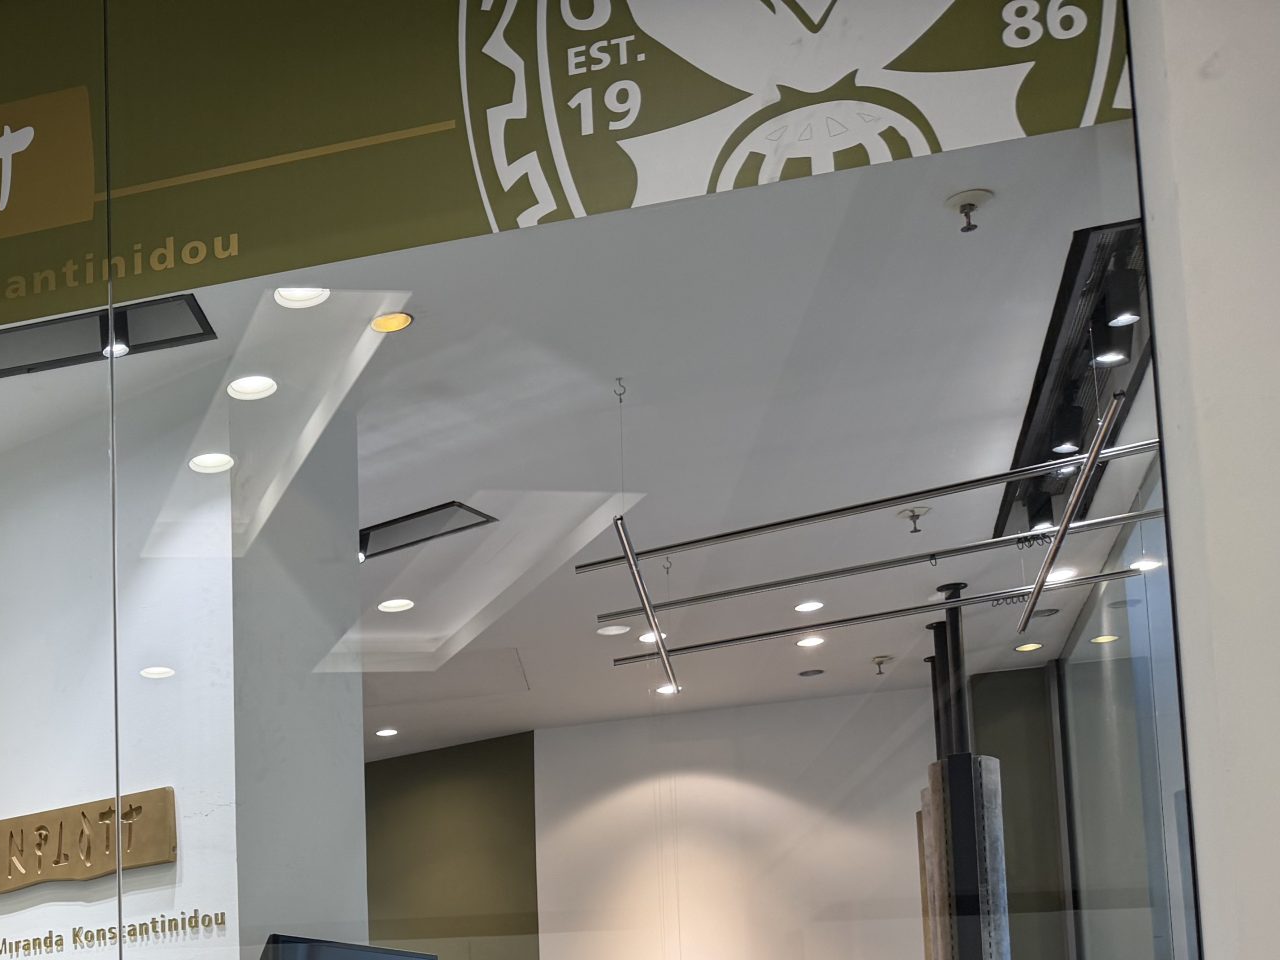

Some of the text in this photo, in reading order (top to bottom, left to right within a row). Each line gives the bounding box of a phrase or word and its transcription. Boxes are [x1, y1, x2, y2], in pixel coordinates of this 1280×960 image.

[1001, 0, 1088, 49] 86
[566, 35, 646, 77] EST.
[566, 79, 643, 137] 19
